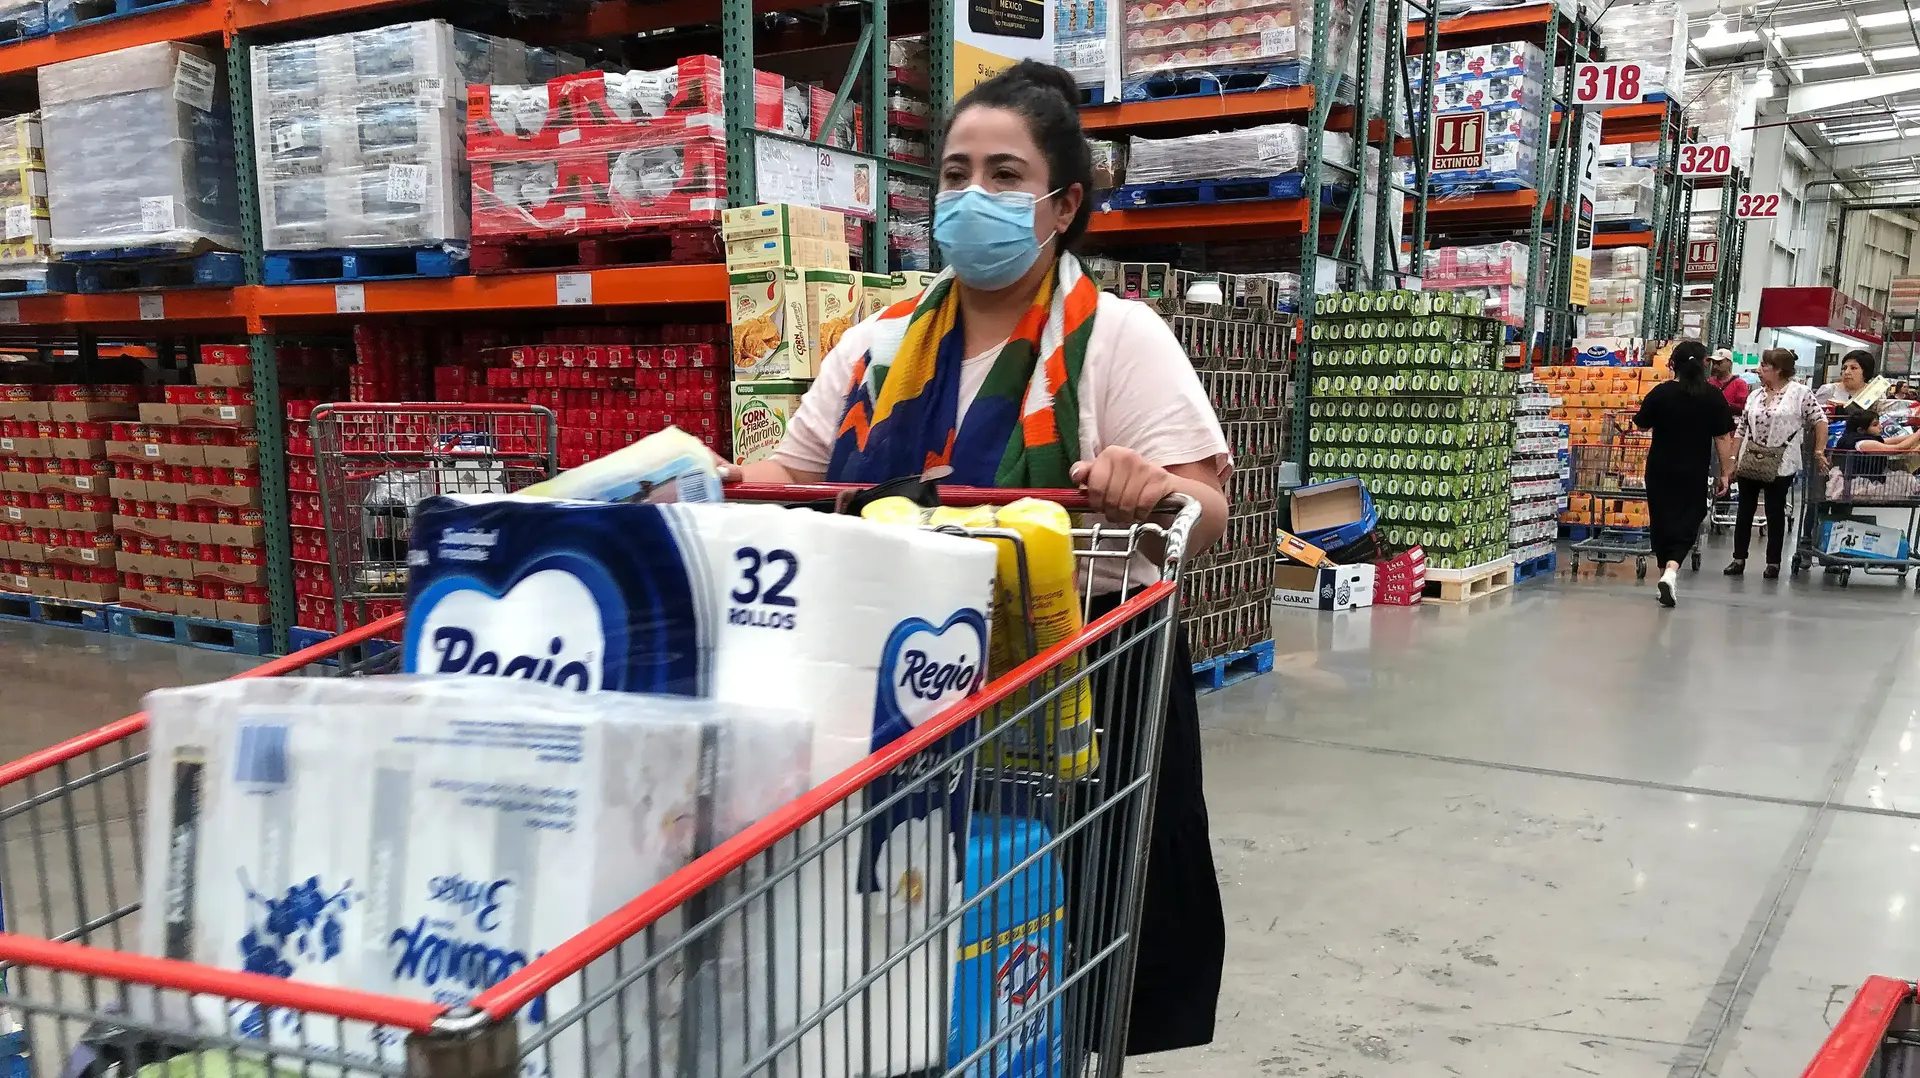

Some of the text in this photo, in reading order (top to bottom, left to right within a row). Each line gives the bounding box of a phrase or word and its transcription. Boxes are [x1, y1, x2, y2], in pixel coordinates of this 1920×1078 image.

[1577, 64, 1641, 101] 318
[1434, 156, 1480, 169] EXTINTOR
[1680, 145, 1731, 173] 320
[1737, 194, 1779, 217] 322
[1687, 263, 1716, 271] EXTINTOR
[794, 333, 804, 356] CORN
[742, 409, 766, 426] CORN
[747, 418, 769, 435] flakes
[739, 421, 781, 453] Amaranto
[731, 546, 798, 607] 32
[1283, 595, 1310, 604] GARAT
[727, 608, 796, 630] ROLLOS
[900, 649, 976, 701] Regio
